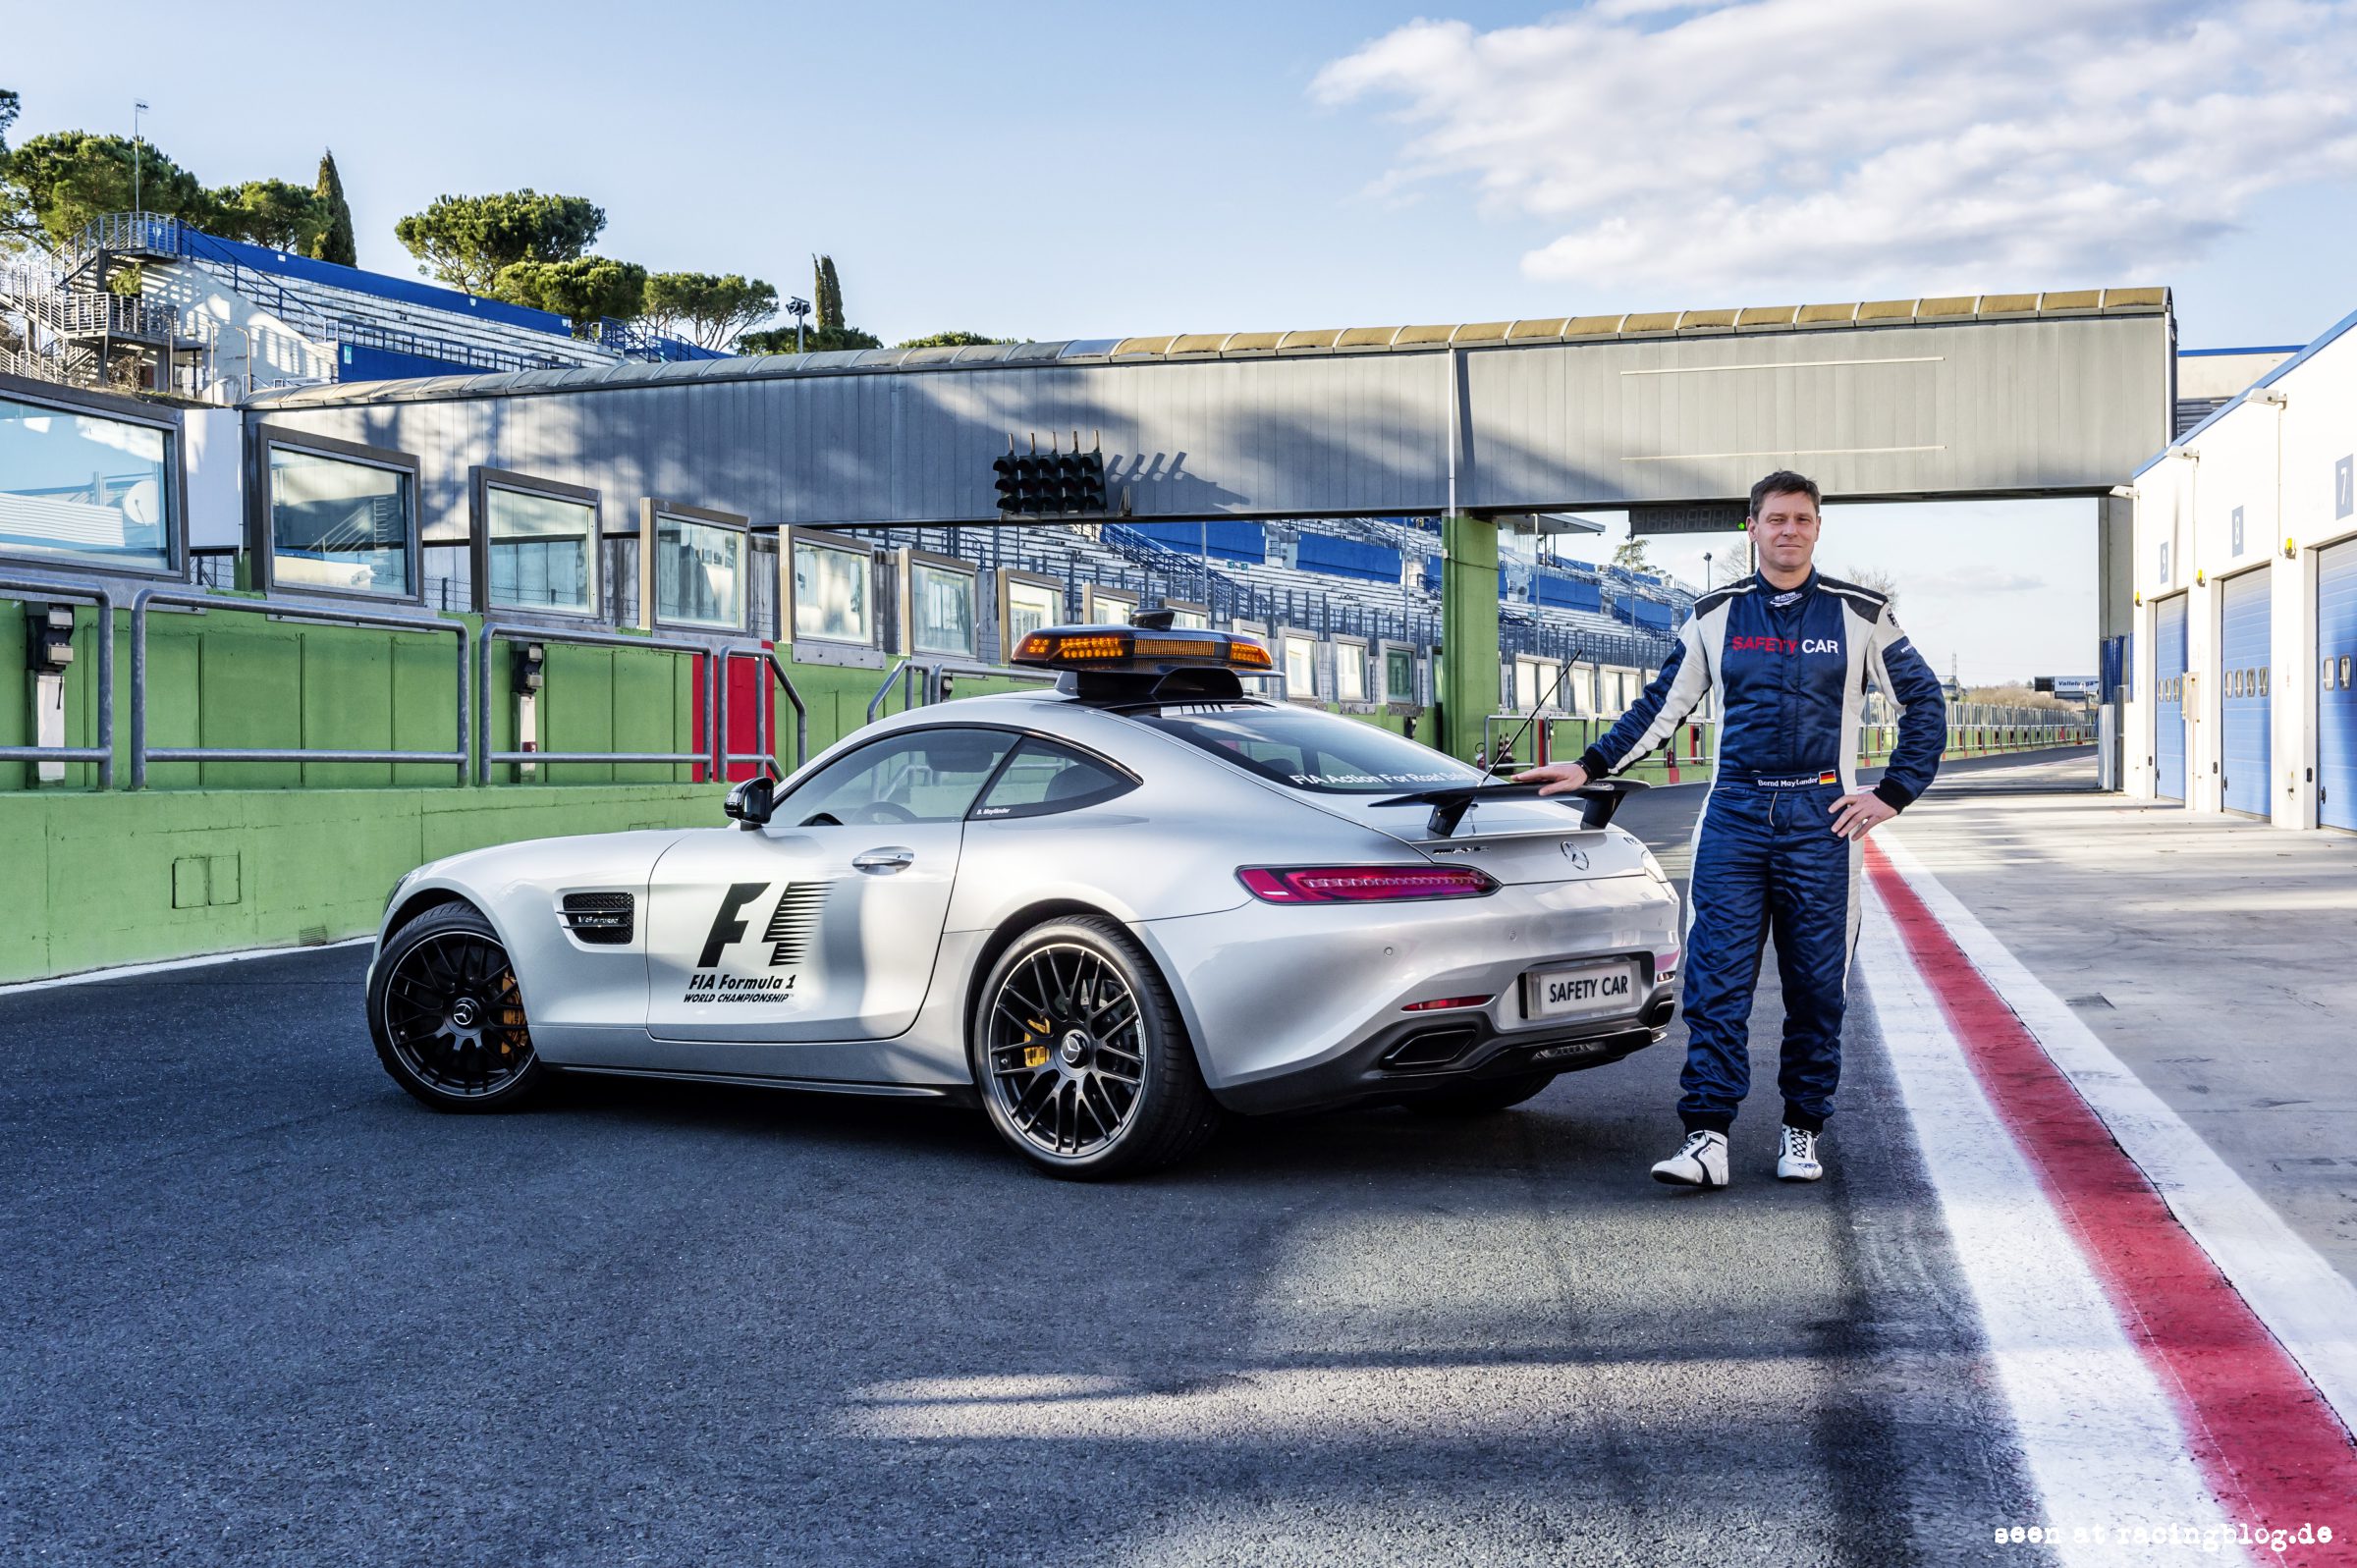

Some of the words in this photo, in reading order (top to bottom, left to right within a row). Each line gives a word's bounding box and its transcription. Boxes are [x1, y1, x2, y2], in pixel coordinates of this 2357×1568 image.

[2340, 466, 2348, 506] 7
[2234, 515, 2240, 545] 8
[1731, 635, 1798, 655] SAFETY
[1801, 638, 1838, 655] CAR
[1289, 774, 1327, 784] FIA
[1326, 774, 1383, 784] Action
[1380, 773, 1408, 783] For
[1405, 772, 1447, 783] Road
[1757, 779, 1779, 787] Bernd
[696, 881, 838, 968] F1
[687, 974, 716, 990] FIA
[718, 974, 784, 990] Formula
[785, 974, 796, 990] 1
[1549, 978, 1599, 1003] SAFETY
[1602, 975, 1628, 997] CAR
[684, 993, 716, 1003] WORLD
